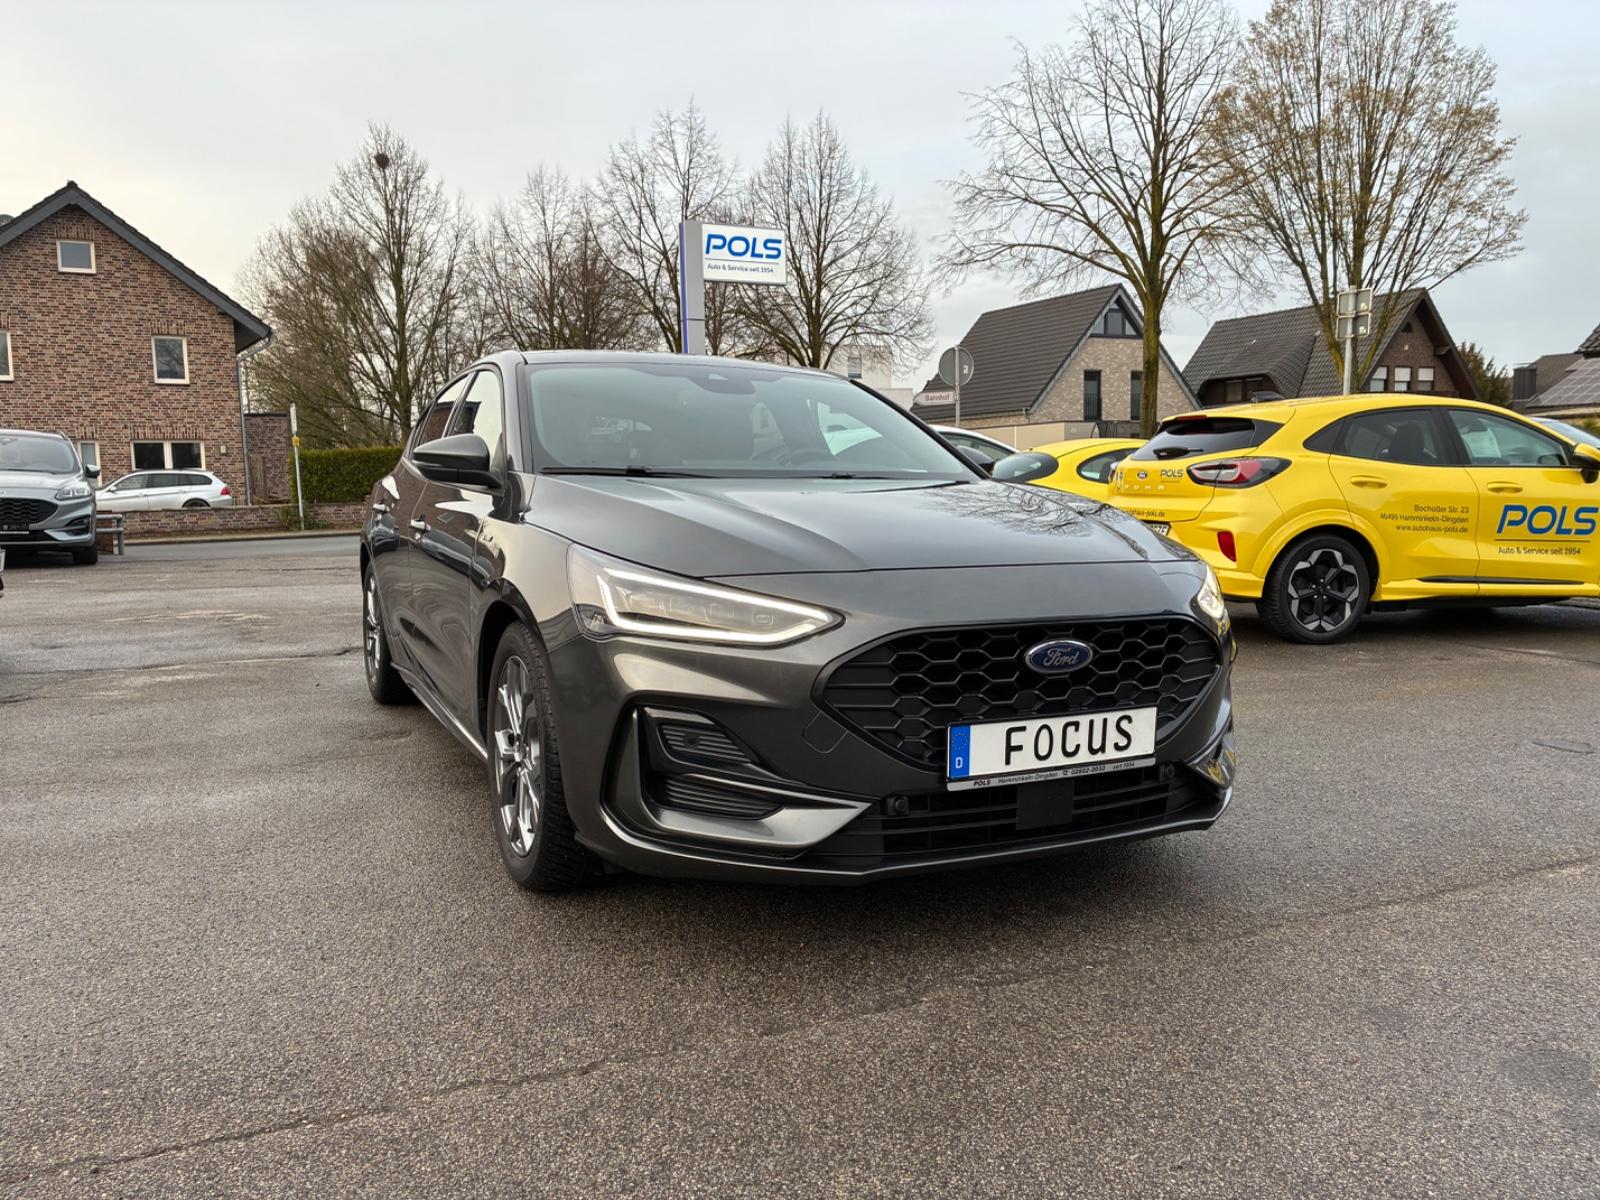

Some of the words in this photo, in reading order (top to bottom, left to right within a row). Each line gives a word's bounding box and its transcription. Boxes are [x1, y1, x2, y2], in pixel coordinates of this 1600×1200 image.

[705, 234, 782, 259] POLS
[728, 264, 748, 272] Service
[1160, 469, 1184, 478] POLS
[1449, 505, 1459, 513] Str.
[1497, 504, 1599, 535] POLS
[1523, 546, 1549, 555] Service
[1043, 647, 1080, 666] Ford
[1005, 715, 1133, 766] FOCUS
[956, 757, 963, 769] D
[973, 779, 991, 787] POLS
